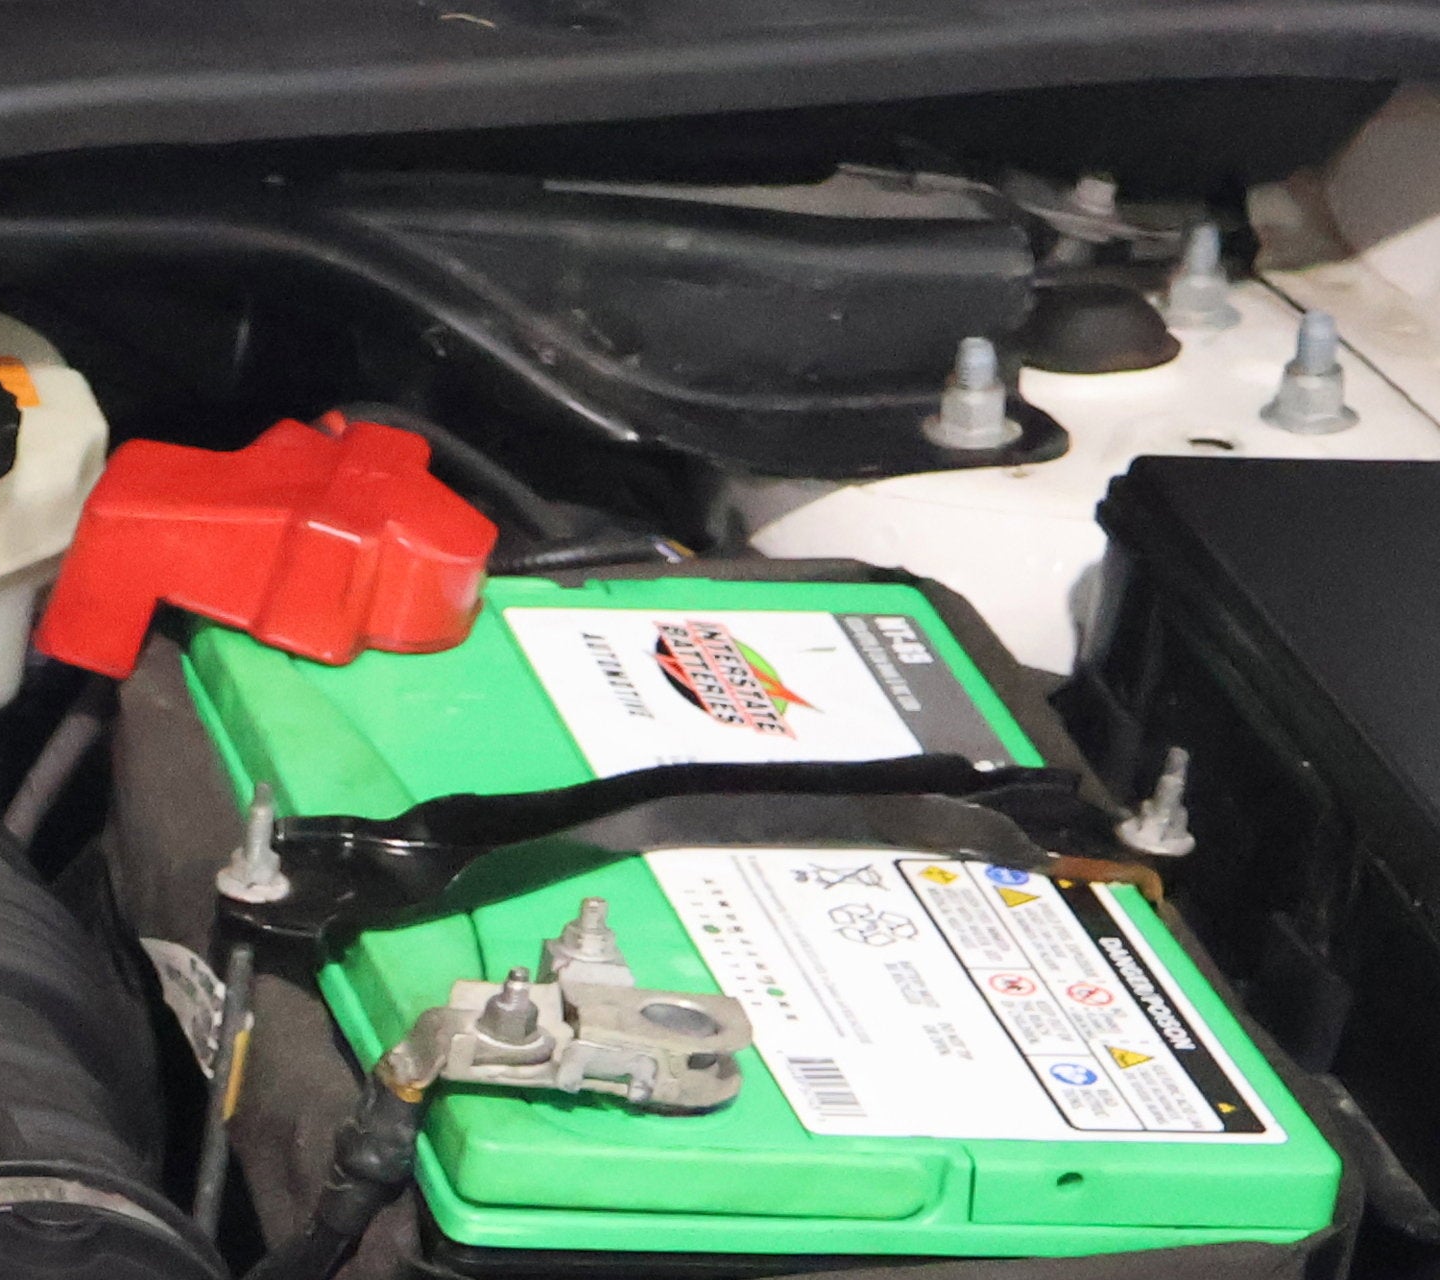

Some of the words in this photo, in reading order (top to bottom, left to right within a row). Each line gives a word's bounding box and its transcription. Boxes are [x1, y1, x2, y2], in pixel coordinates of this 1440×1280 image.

[581, 631, 656, 720] AUTOMOTIVE
[661, 625, 745, 724] BATTERIES
[692, 622, 786, 733] INTERSTATE
